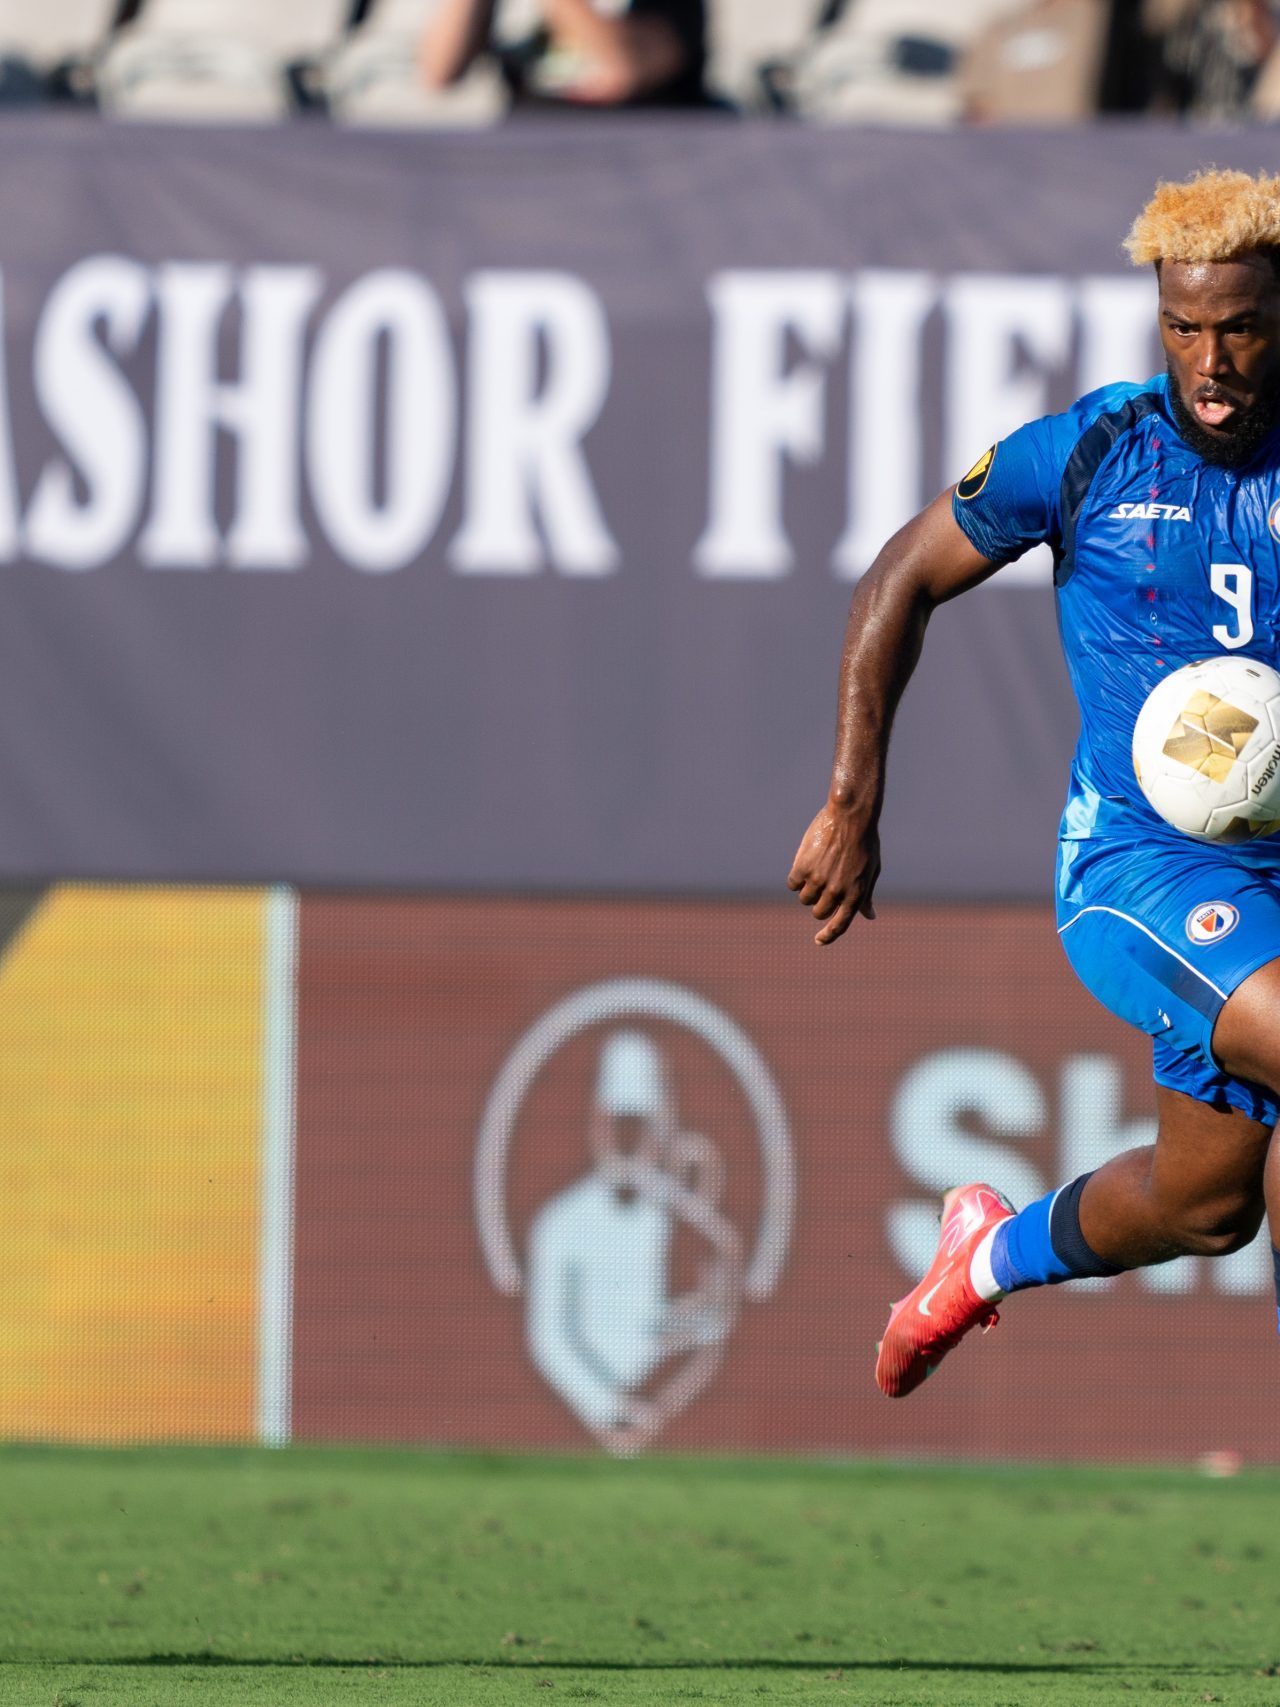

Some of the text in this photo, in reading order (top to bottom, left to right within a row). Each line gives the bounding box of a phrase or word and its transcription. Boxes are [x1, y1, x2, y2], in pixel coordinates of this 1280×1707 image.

[0, 254, 619, 577] SHOR
[1108, 503, 1191, 522] SAETA
[1210, 563, 1253, 649] 9
